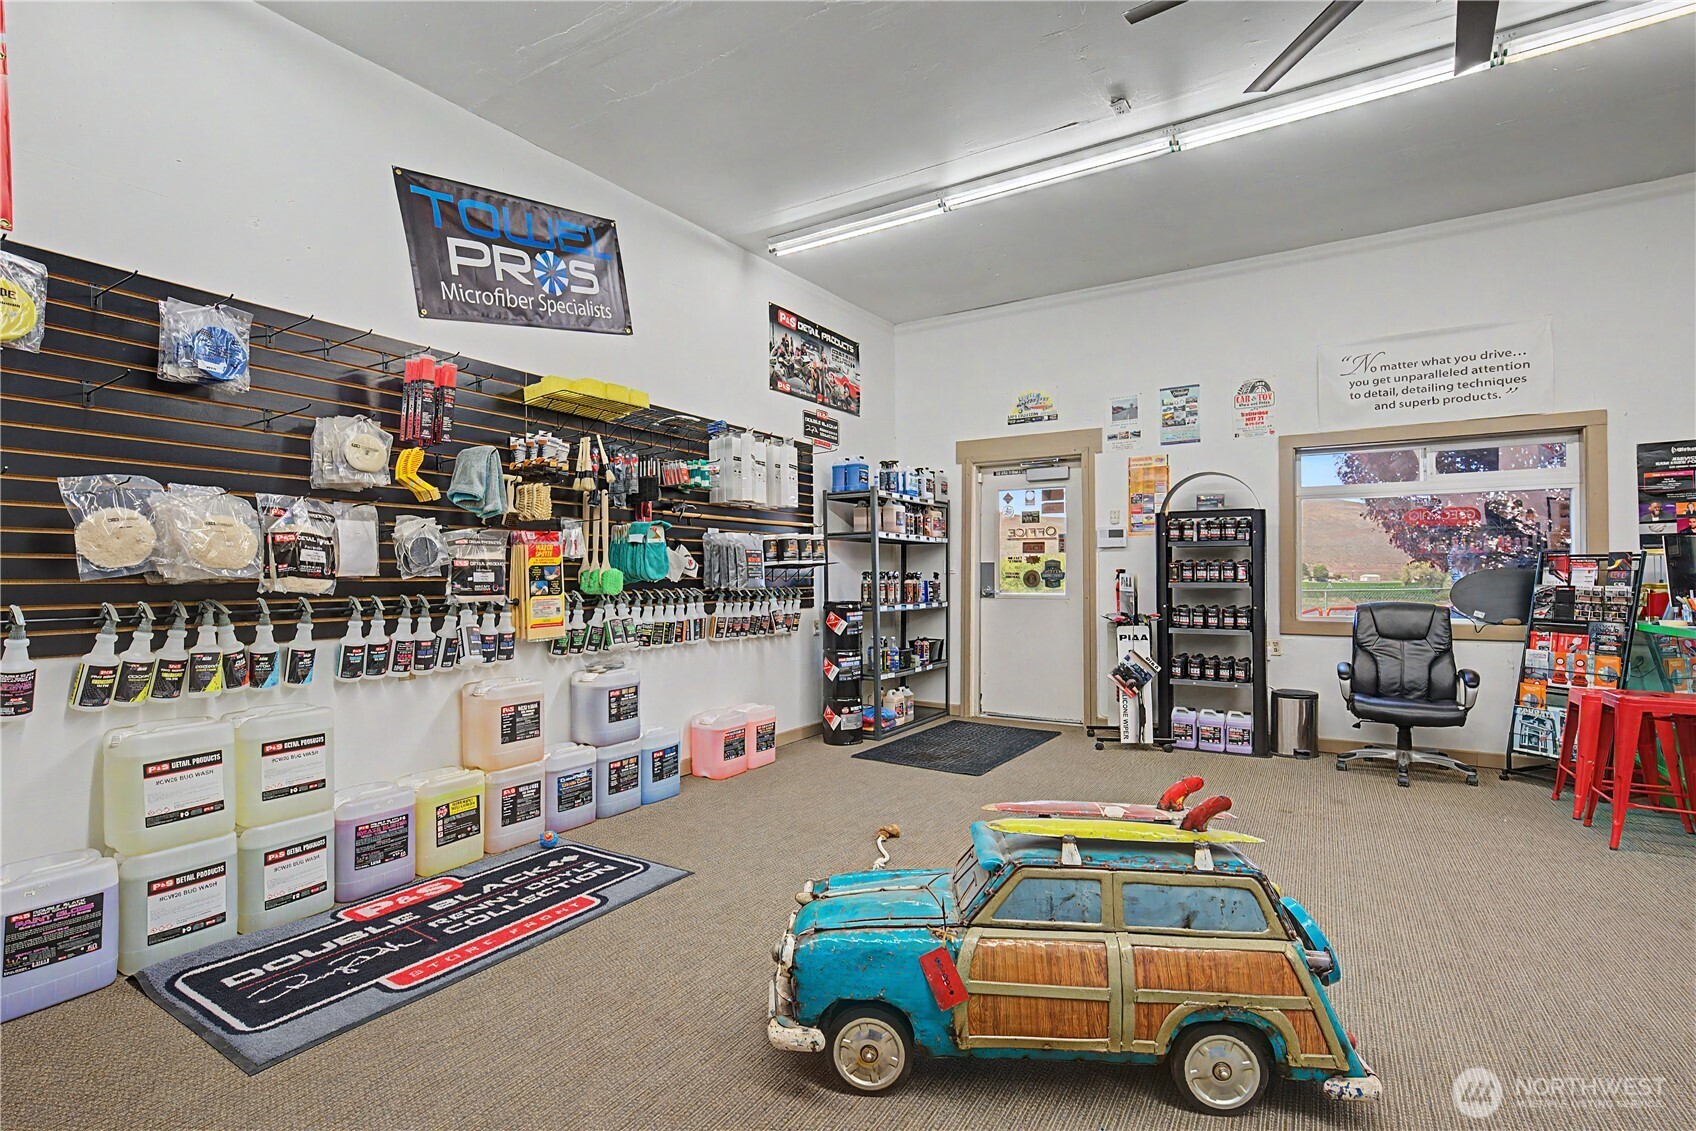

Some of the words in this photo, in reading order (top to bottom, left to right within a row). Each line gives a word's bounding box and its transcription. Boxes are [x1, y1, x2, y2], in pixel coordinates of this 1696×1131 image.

[409, 184, 613, 261] TOWEL
[440, 281, 534, 310] Microfiber
[539, 295, 612, 319] Specialists
[779, 312, 797, 328] P&S
[797, 321, 820, 339] DETAIL
[821, 332, 855, 353] PRODUCTS
[1349, 379, 1369, 390] you
[1372, 375, 1391, 387] get
[1393, 367, 1468, 385] unparalleled
[1471, 361, 1531, 375] attention
[1380, 360, 1418, 372] matter
[1421, 356, 1451, 367] what
[1454, 354, 1477, 369] you
[1236, 395, 1250, 404] CAR
[1350, 391, 1361, 400] to
[1363, 387, 1399, 399] detail,
[1401, 381, 1454, 396] detailing
[1457, 374, 1528, 391] techniques
[1374, 400, 1396, 411] and
[1399, 396, 1440, 411] superb
[265, 743, 283, 752] P&S
[148, 763, 169, 774] P&S
[171, 759, 191, 769] DETAIL
[192, 753, 221, 765] PRODUCTS
[195, 769, 214, 777] WASH
[268, 851, 285, 861] P&S
[152, 879, 174, 891] P&S
[175, 874, 195, 885] DETAIL
[196, 865, 225, 879] PRODUCTS
[198, 881, 218, 891] WASH
[354, 881, 453, 918] P&S
[427, 889, 520, 929] RENNY
[527, 860, 600, 891] DOYLE
[442, 864, 618, 936] COLLECTION
[15, 913, 53, 929] PAINT
[220, 911, 421, 988] DOUBLE
[427, 867, 550, 911] BLACK
[408, 938, 498, 978] STORE
